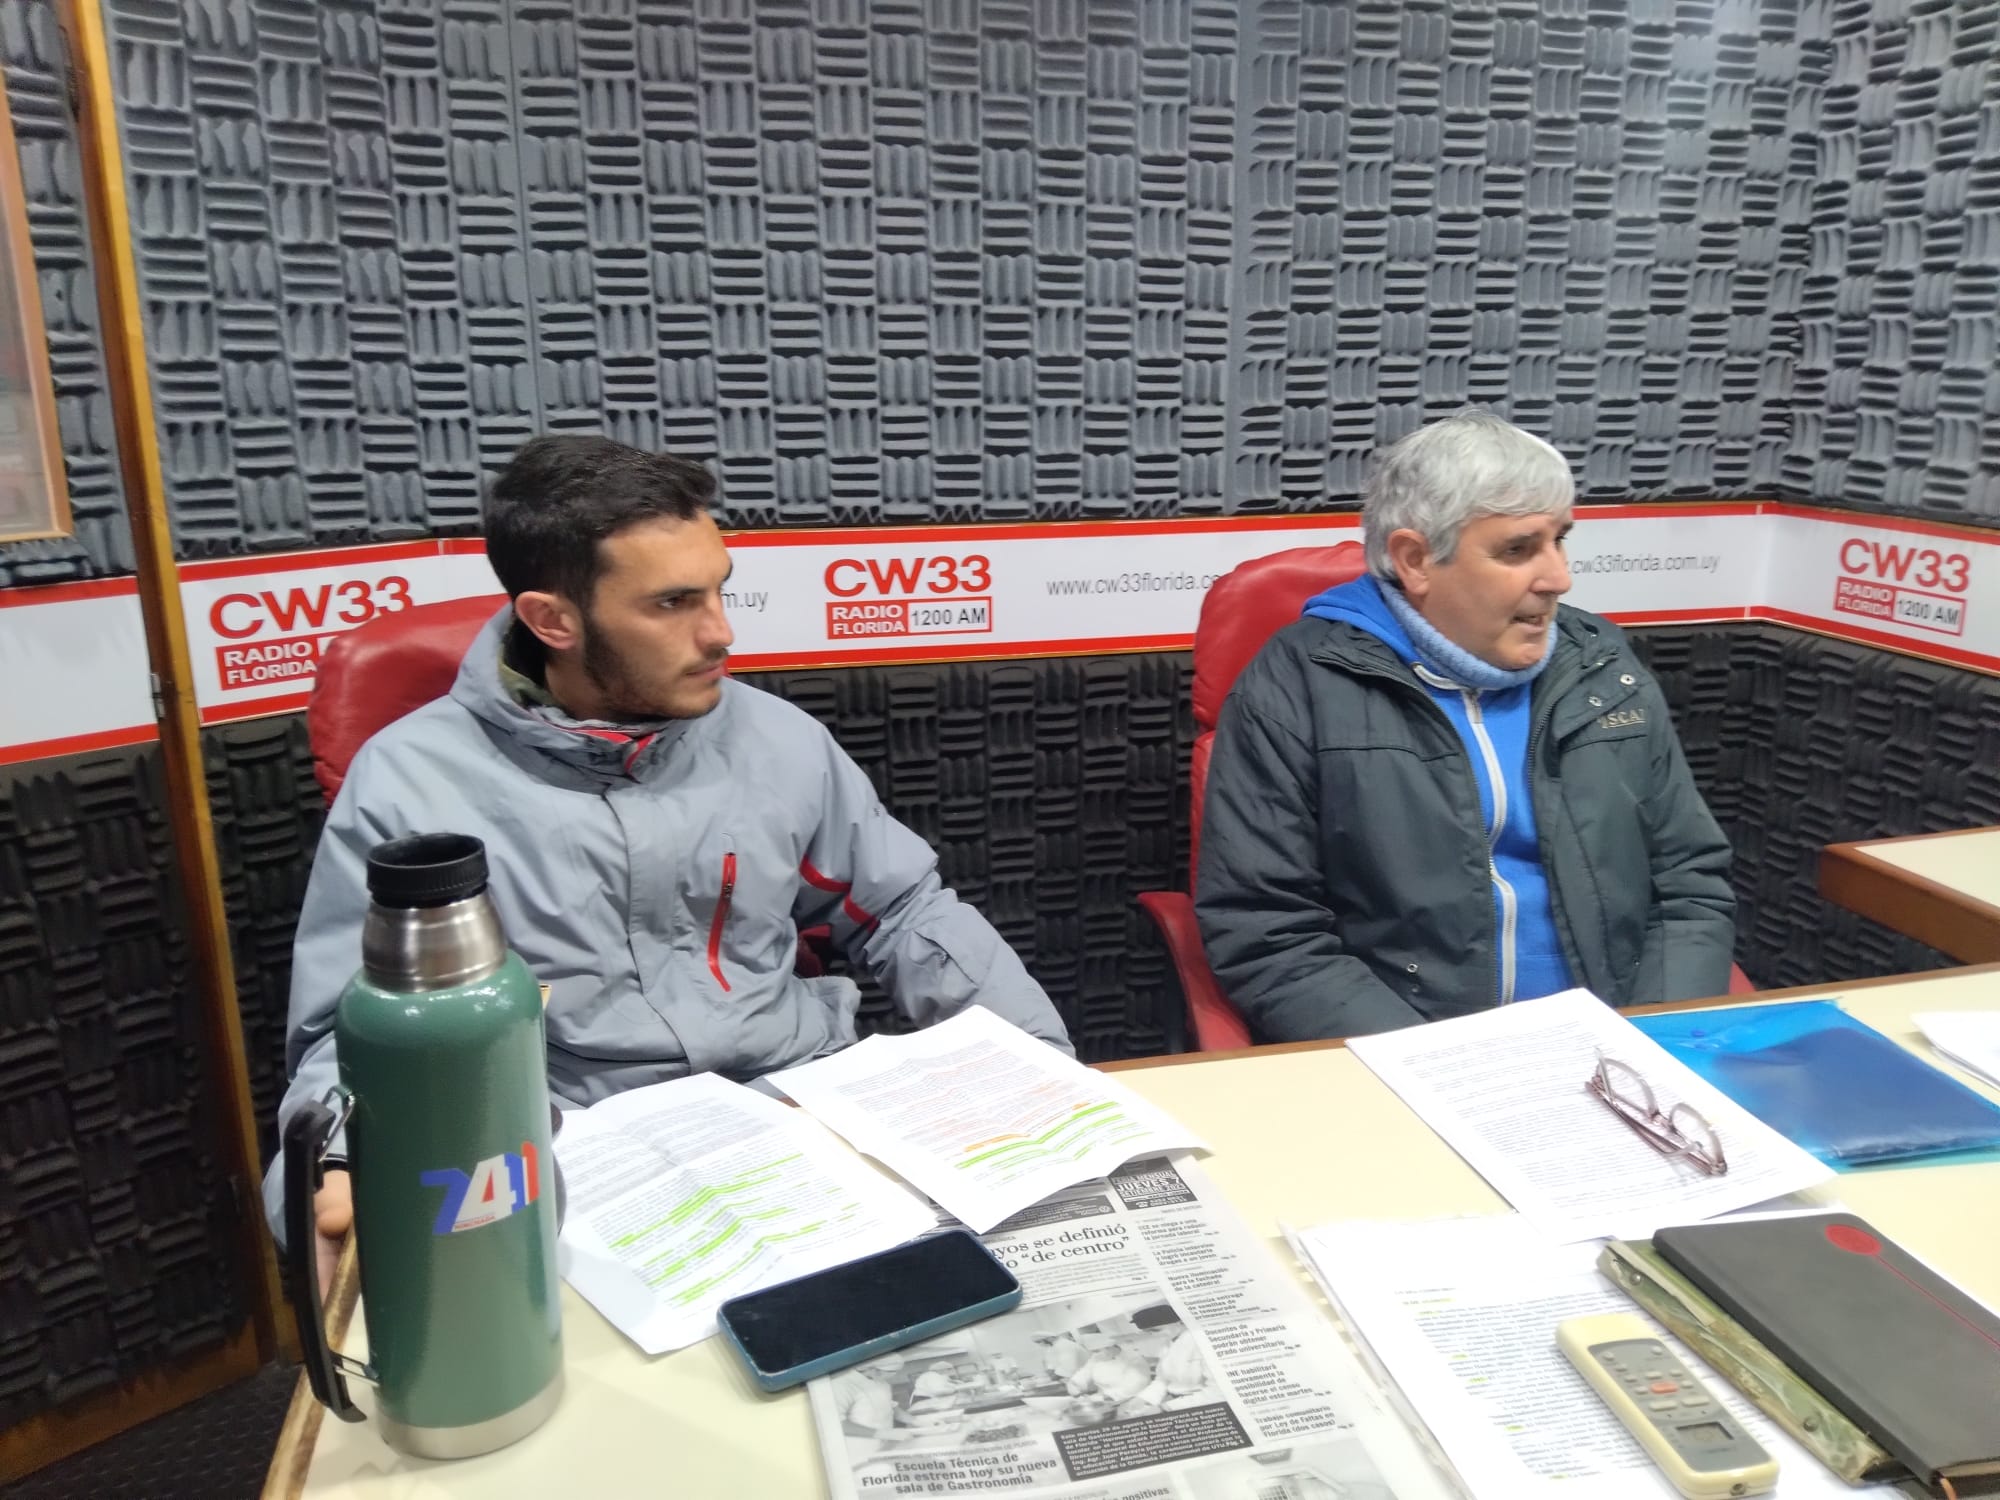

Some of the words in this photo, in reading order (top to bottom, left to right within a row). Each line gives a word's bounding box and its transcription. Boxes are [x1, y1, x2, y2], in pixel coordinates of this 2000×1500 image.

[1566, 553, 1720, 574] .cw33florida.com.uy
[1840, 538, 1970, 592] CW33
[824, 554, 992, 598] CW33
[720, 592, 769, 612] m.uy
[1839, 581, 1893, 602] RADIO
[209, 576, 414, 639] CW33
[832, 604, 903, 620] RADIO
[911, 609, 952, 626] 1200
[957, 607, 986, 624] AM
[1837, 596, 1891, 617] FLORIDA
[1899, 599, 1931, 619] 1200
[1935, 606, 1960, 625] AM
[833, 621, 905, 635] FLORIDA
[224, 641, 312, 667] RADIO
[226, 659, 317, 685] FLORIDA
[1117, 1178, 1169, 1191] JUEVES
[990, 1242, 1029, 1259] yos
[1033, 1237, 1055, 1249] se
[1059, 1223, 1126, 1243] definió
[861, 1473, 910, 1486] Florida
[914, 1471, 966, 1482] estrena
[969, 1468, 993, 1478] hoy
[997, 1466, 1013, 1475] su
[1017, 1459, 1057, 1472] nueva
[894, 1461, 946, 1471] Escuela
[949, 1457, 999, 1468] Técnica
[1002, 1453, 1018, 1463] de
[896, 1483, 923, 1494] sala
[927, 1482, 944, 1491] de
[947, 1474, 1032, 1490] Gastronomía
[1122, 1487, 1170, 1500] positivas
